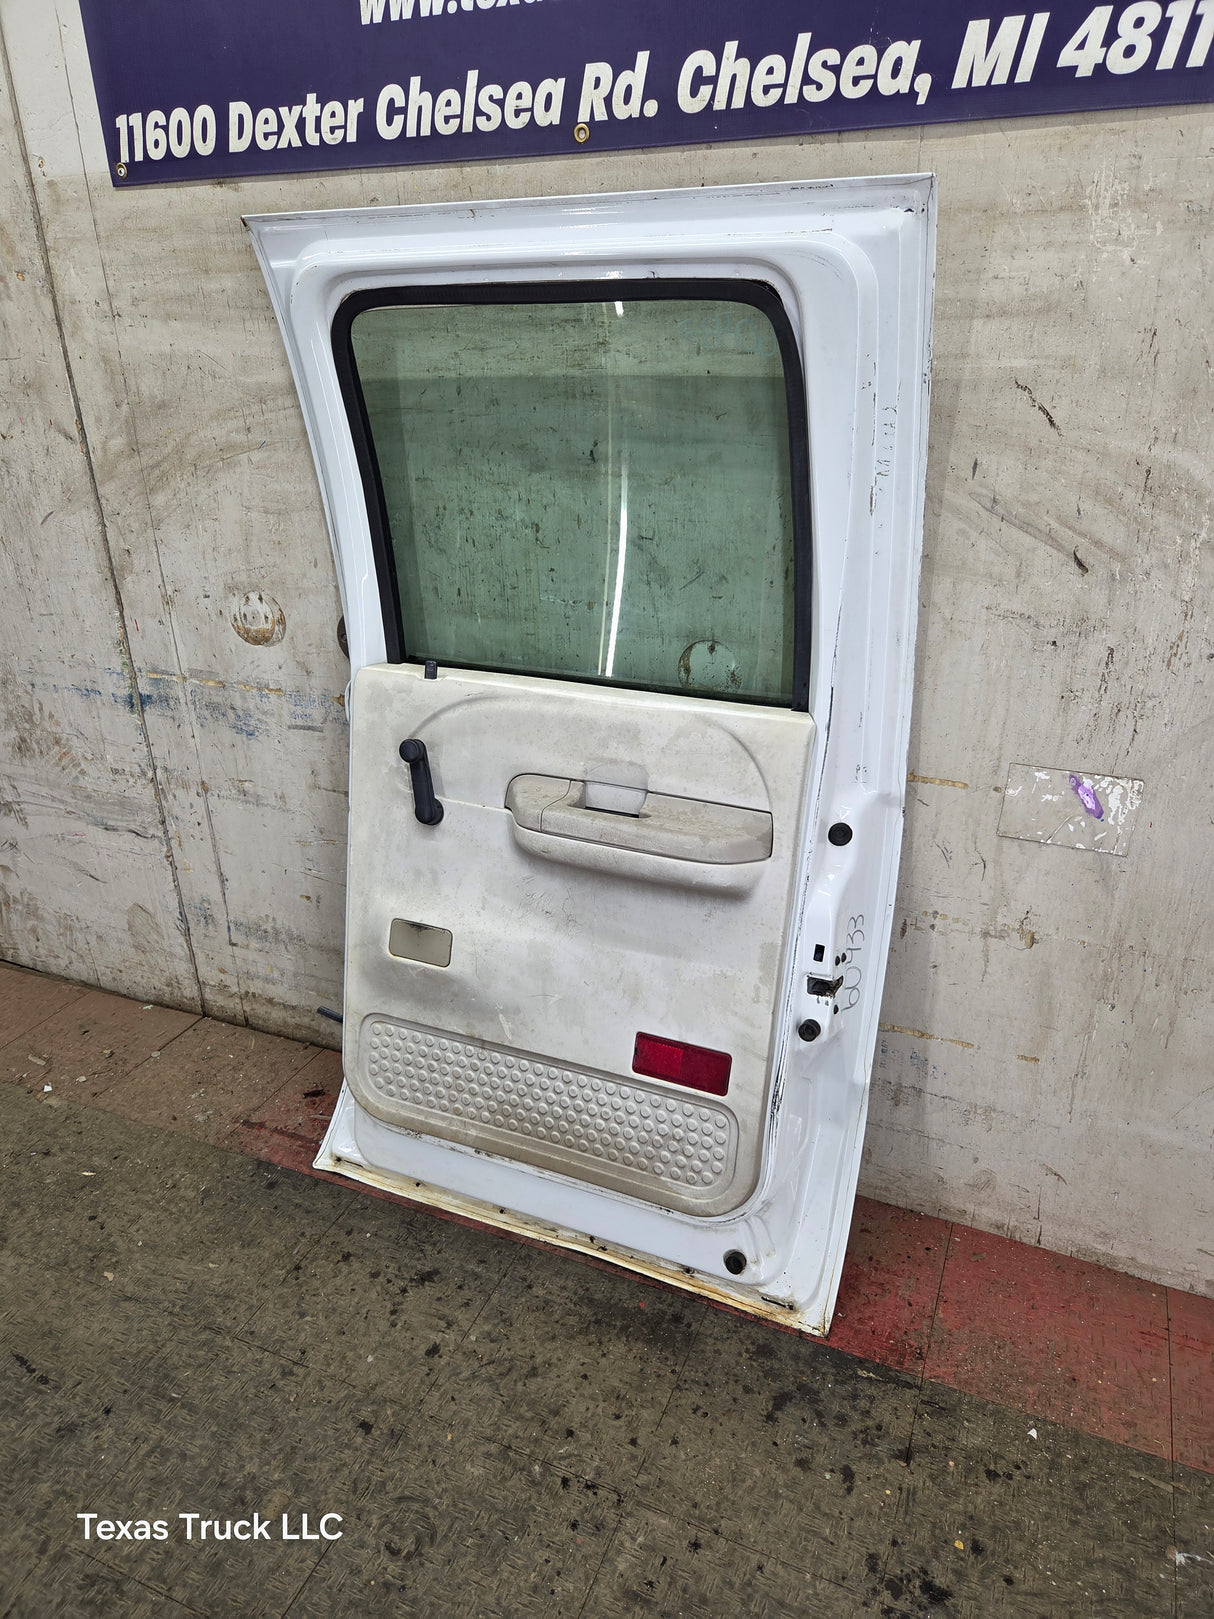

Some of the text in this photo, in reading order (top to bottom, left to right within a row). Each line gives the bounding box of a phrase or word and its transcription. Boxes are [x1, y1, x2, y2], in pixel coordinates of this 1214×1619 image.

[116, 104, 217, 163] 11600
[229, 92, 364, 154] Dexter
[375, 69, 566, 141] Chelsea
[578, 50, 658, 123] Rd.
[677, 32, 931, 114] Chelsea,
[951, 12, 1051, 89] MI
